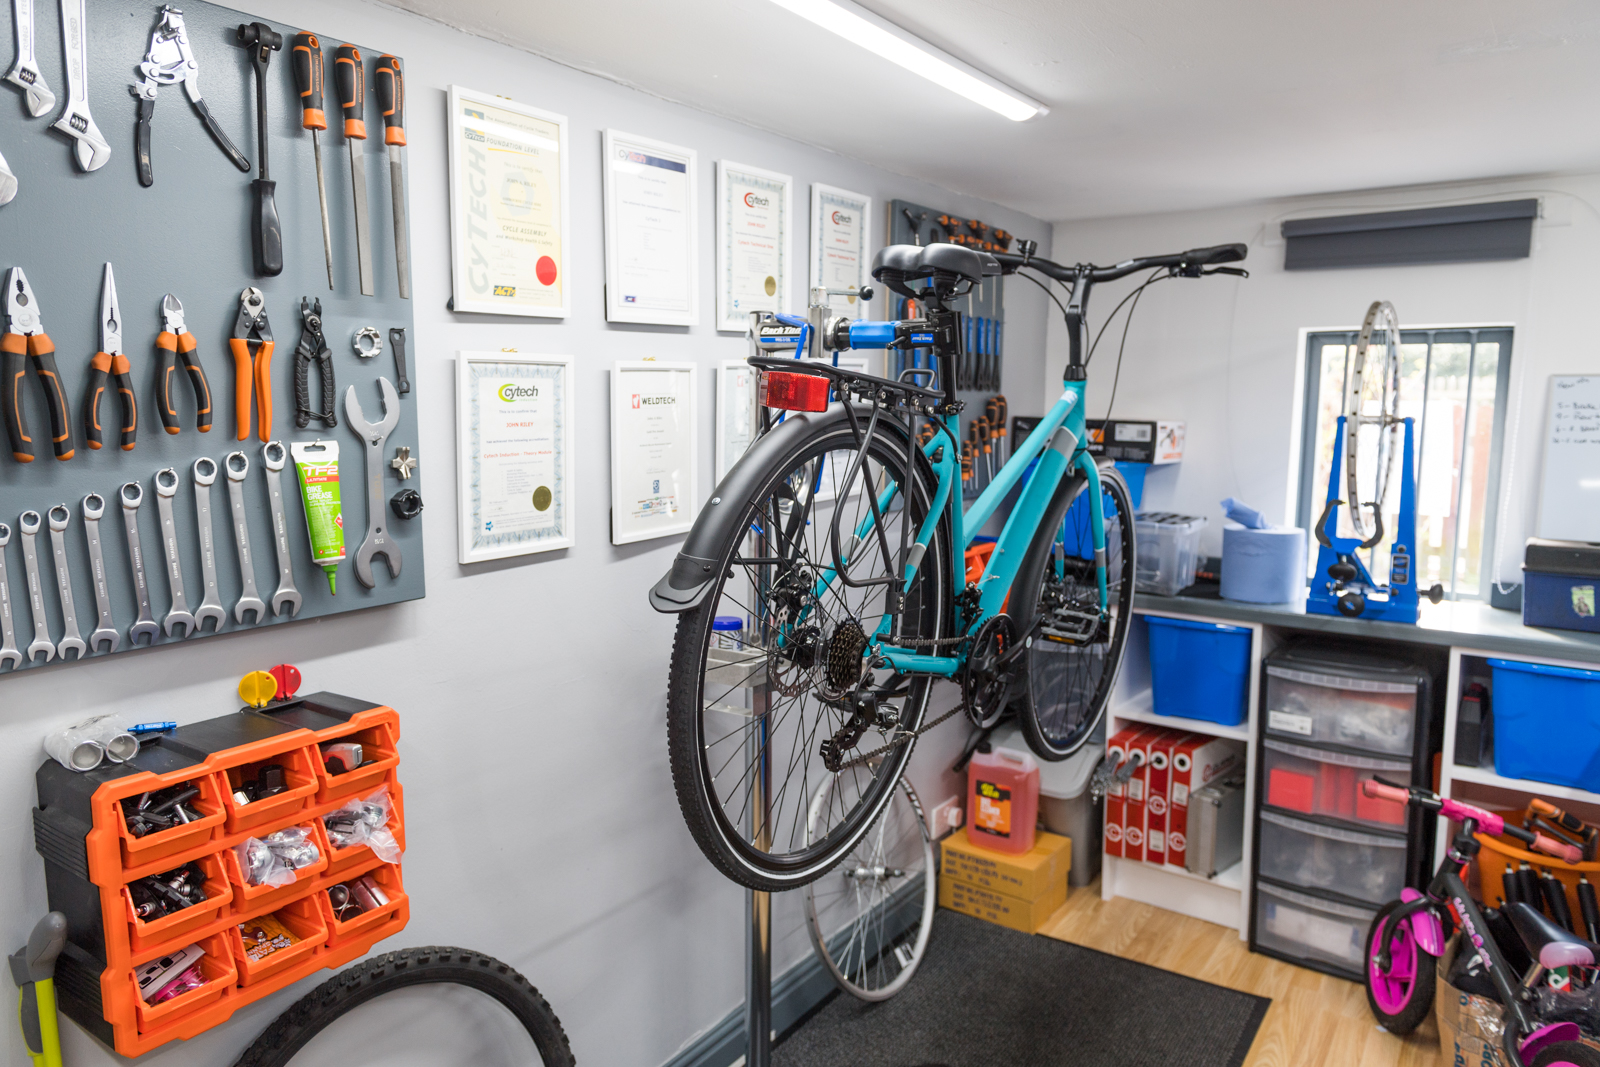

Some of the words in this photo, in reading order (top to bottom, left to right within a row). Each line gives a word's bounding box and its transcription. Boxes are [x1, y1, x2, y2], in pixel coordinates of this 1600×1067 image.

[486, 137, 522, 150] FOUNDATION
[524, 147, 539, 155] LEVEL
[502, 225, 518, 233] CYCLE
[520, 228, 547, 237] ASSEMBLY
[761, 326, 784, 335] Park
[784, 326, 802, 335] Too
[504, 385, 538, 400] cytech
[642, 397, 676, 405] WELDTECH
[303, 465, 338, 477] TF2
[306, 485, 322, 494] BIKE
[307, 491, 333, 501] GREASE
[255, 945, 275, 959] FAT
